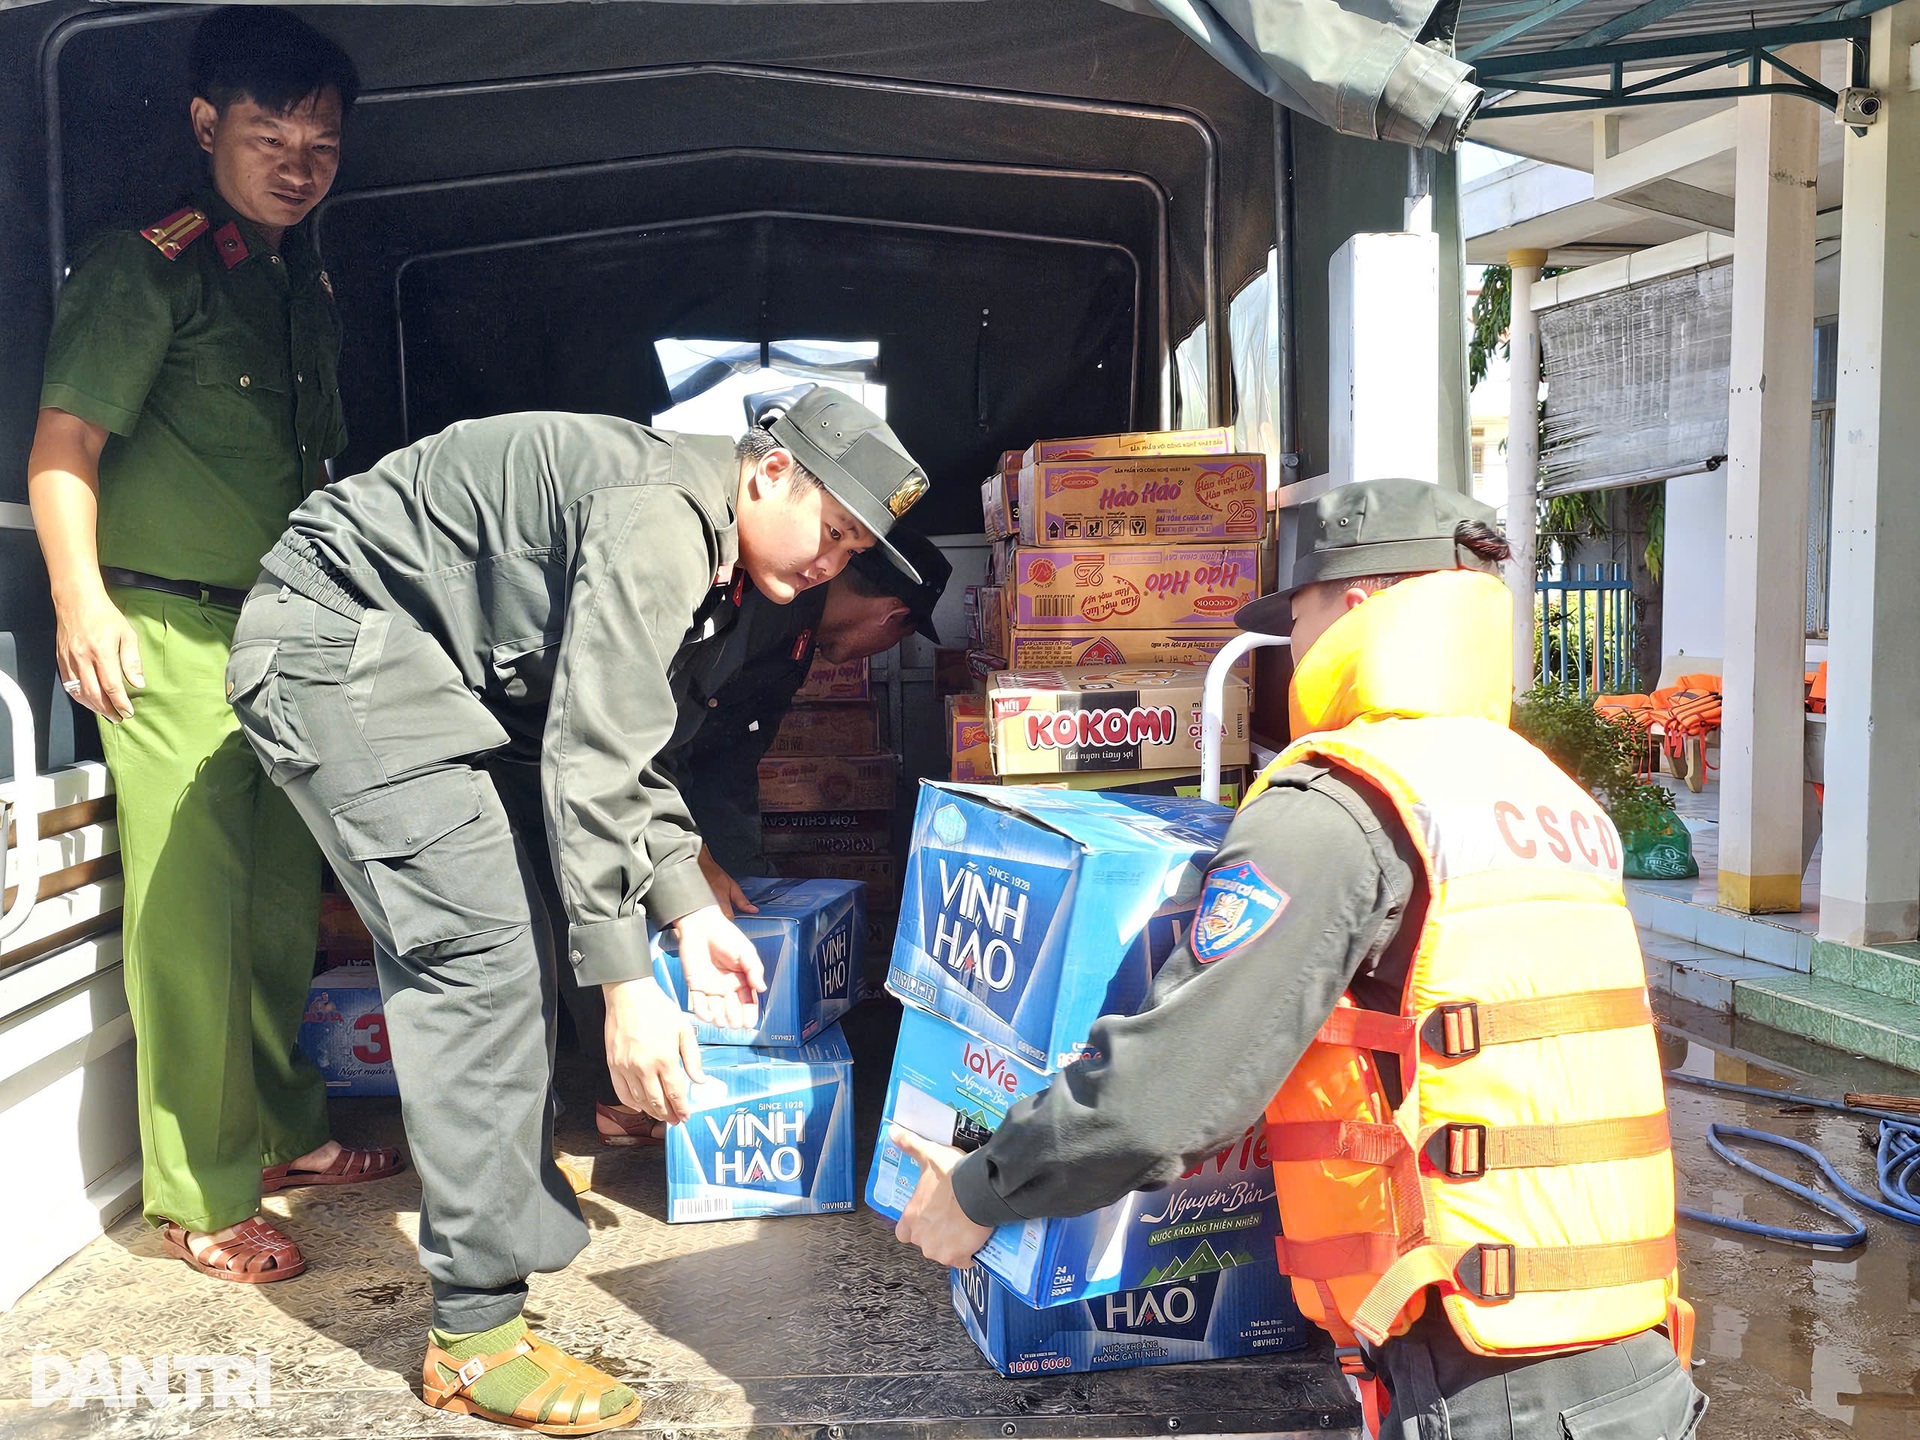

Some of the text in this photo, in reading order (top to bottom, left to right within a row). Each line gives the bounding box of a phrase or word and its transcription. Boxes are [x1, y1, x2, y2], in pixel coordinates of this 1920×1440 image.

[1226, 500, 1258, 526] 25
[1025, 706, 1177, 750] KOKOMI
[986, 865, 1031, 891] SINCE 1928
[938, 858, 1028, 944] VĨNH
[758, 1103, 782, 1111] SINCE
[704, 1107, 806, 1150] VĨNH
[1139, 1181, 1276, 1225] Nguyên Bản
[1150, 1216, 1260, 1243] NƯỚC KHOÁNG THIÊN NHIÊN
[1053, 1274, 1075, 1286] CHAI
[1055, 1266, 1067, 1275] 24
[1092, 1352, 1120, 1364] KHÔNG
[1122, 1352, 1132, 1361] GA
[1102, 1340, 1159, 1354] NƯỚC KHOÁNG
[1008, 1356, 1072, 1374] 1800 6068
